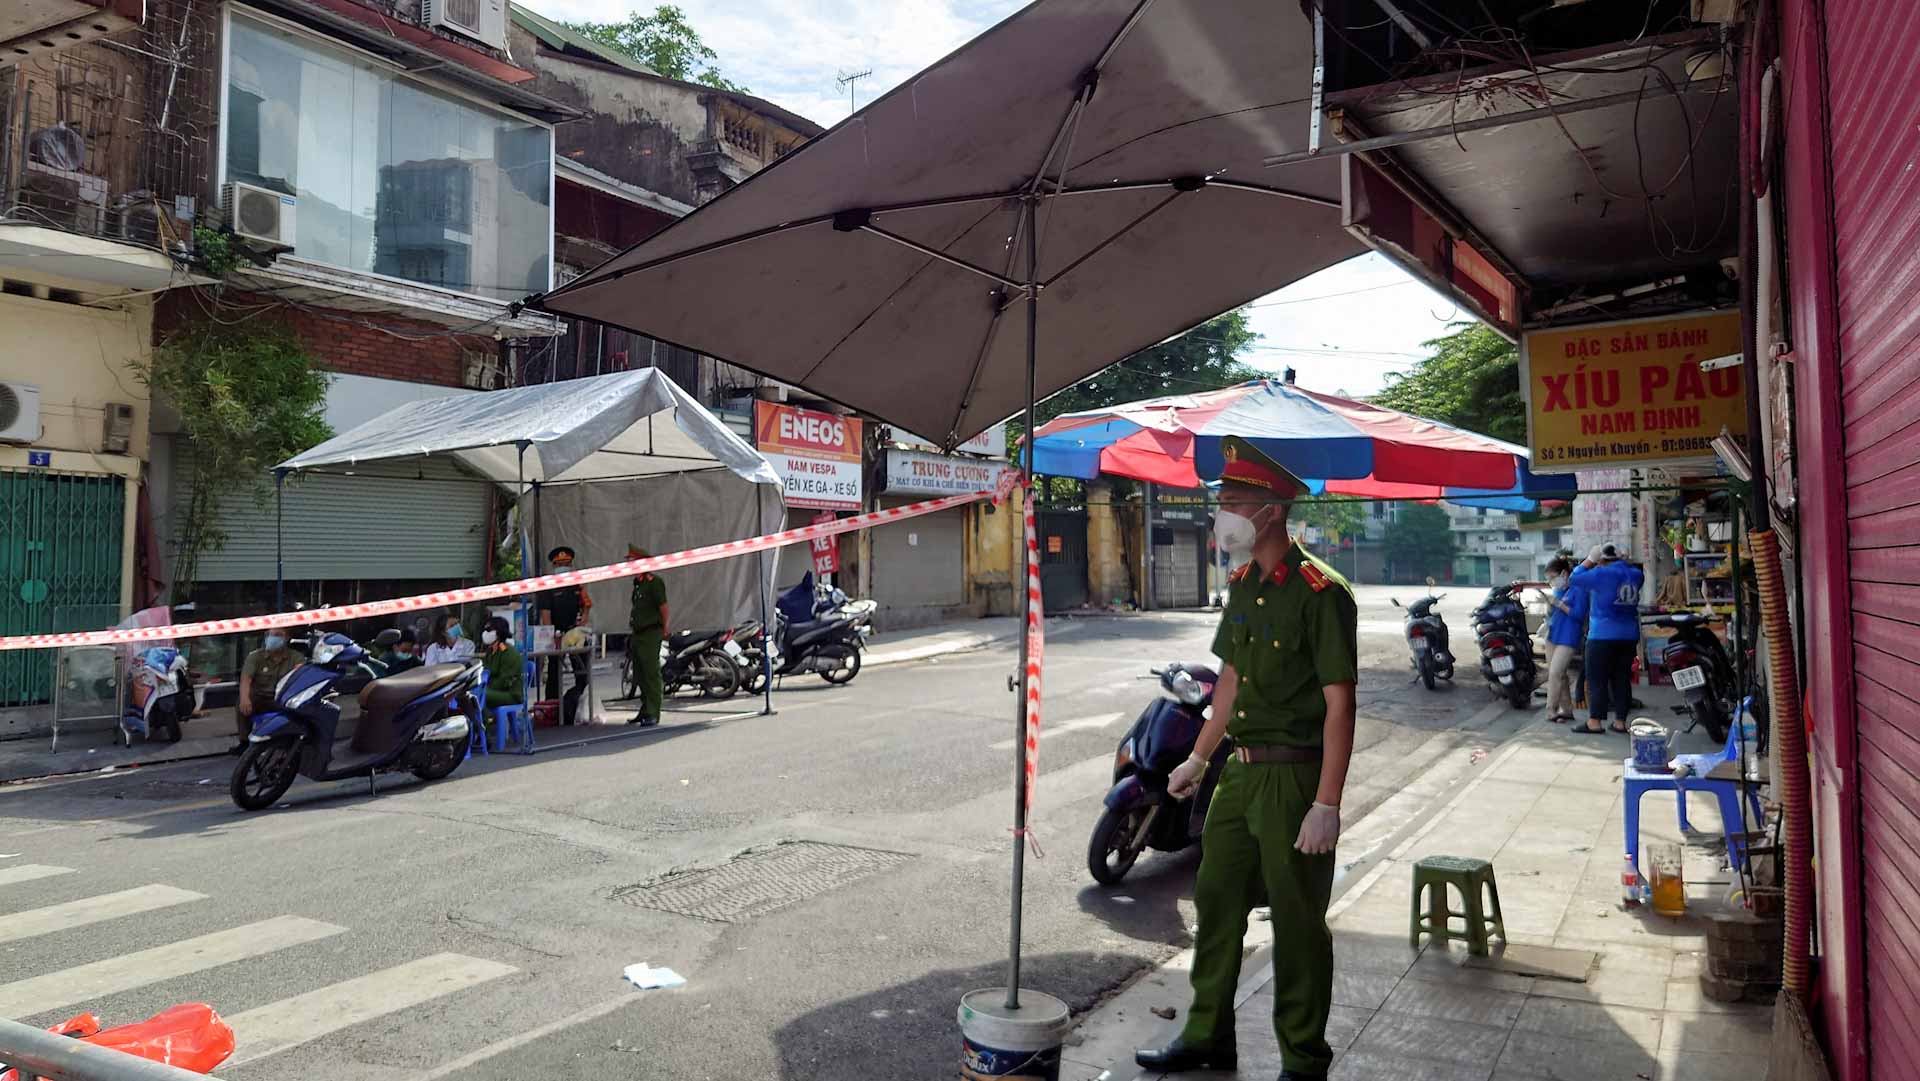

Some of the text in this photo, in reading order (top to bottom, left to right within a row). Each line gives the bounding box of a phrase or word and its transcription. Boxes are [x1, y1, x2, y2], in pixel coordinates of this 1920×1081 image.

[1564, 339, 1601, 361] ĐẶC
[1656, 328, 1710, 349] BÁNH
[1540, 364, 1621, 413] XÍU
[779, 413, 845, 447] ENEOS
[1580, 406, 1702, 436] NAM ĐỊNH
[1558, 447, 1564, 460] 2
[787, 459, 836, 476] NAM VESPA
[911, 460, 951, 479] TRUNG
[781, 475, 801, 492] YÊN
[803, 479, 814, 493] XE
[816, 480, 828, 494] GA
[834, 482, 845, 495] XE
[816, 555, 833, 573] XE
